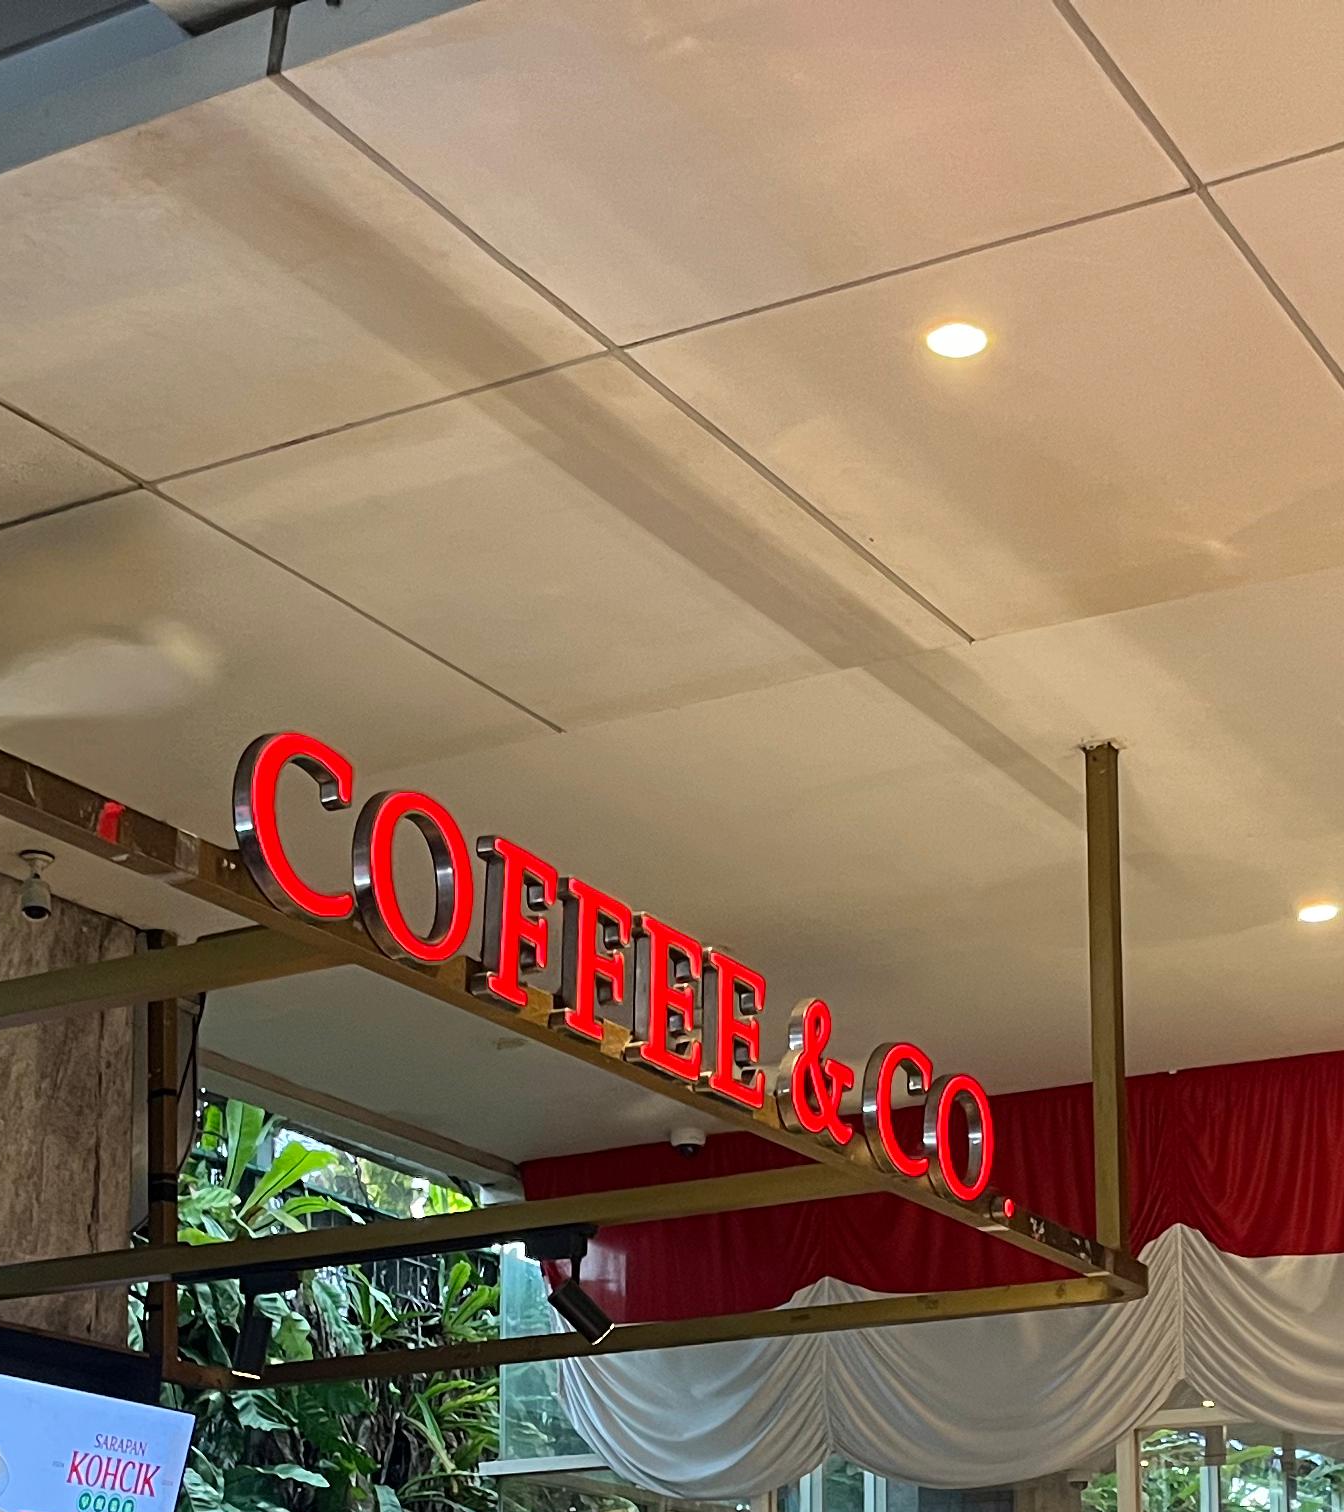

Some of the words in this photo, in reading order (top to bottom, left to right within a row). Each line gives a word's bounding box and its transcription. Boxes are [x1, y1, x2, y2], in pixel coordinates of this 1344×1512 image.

[233, 731, 766, 1110] COFFEE
[776, 997, 855, 1146] &
[862, 1041, 1016, 1220] CO.
[94, 1433, 148, 1457] SARAPAN
[66, 1450, 161, 1498] KOHCIK
